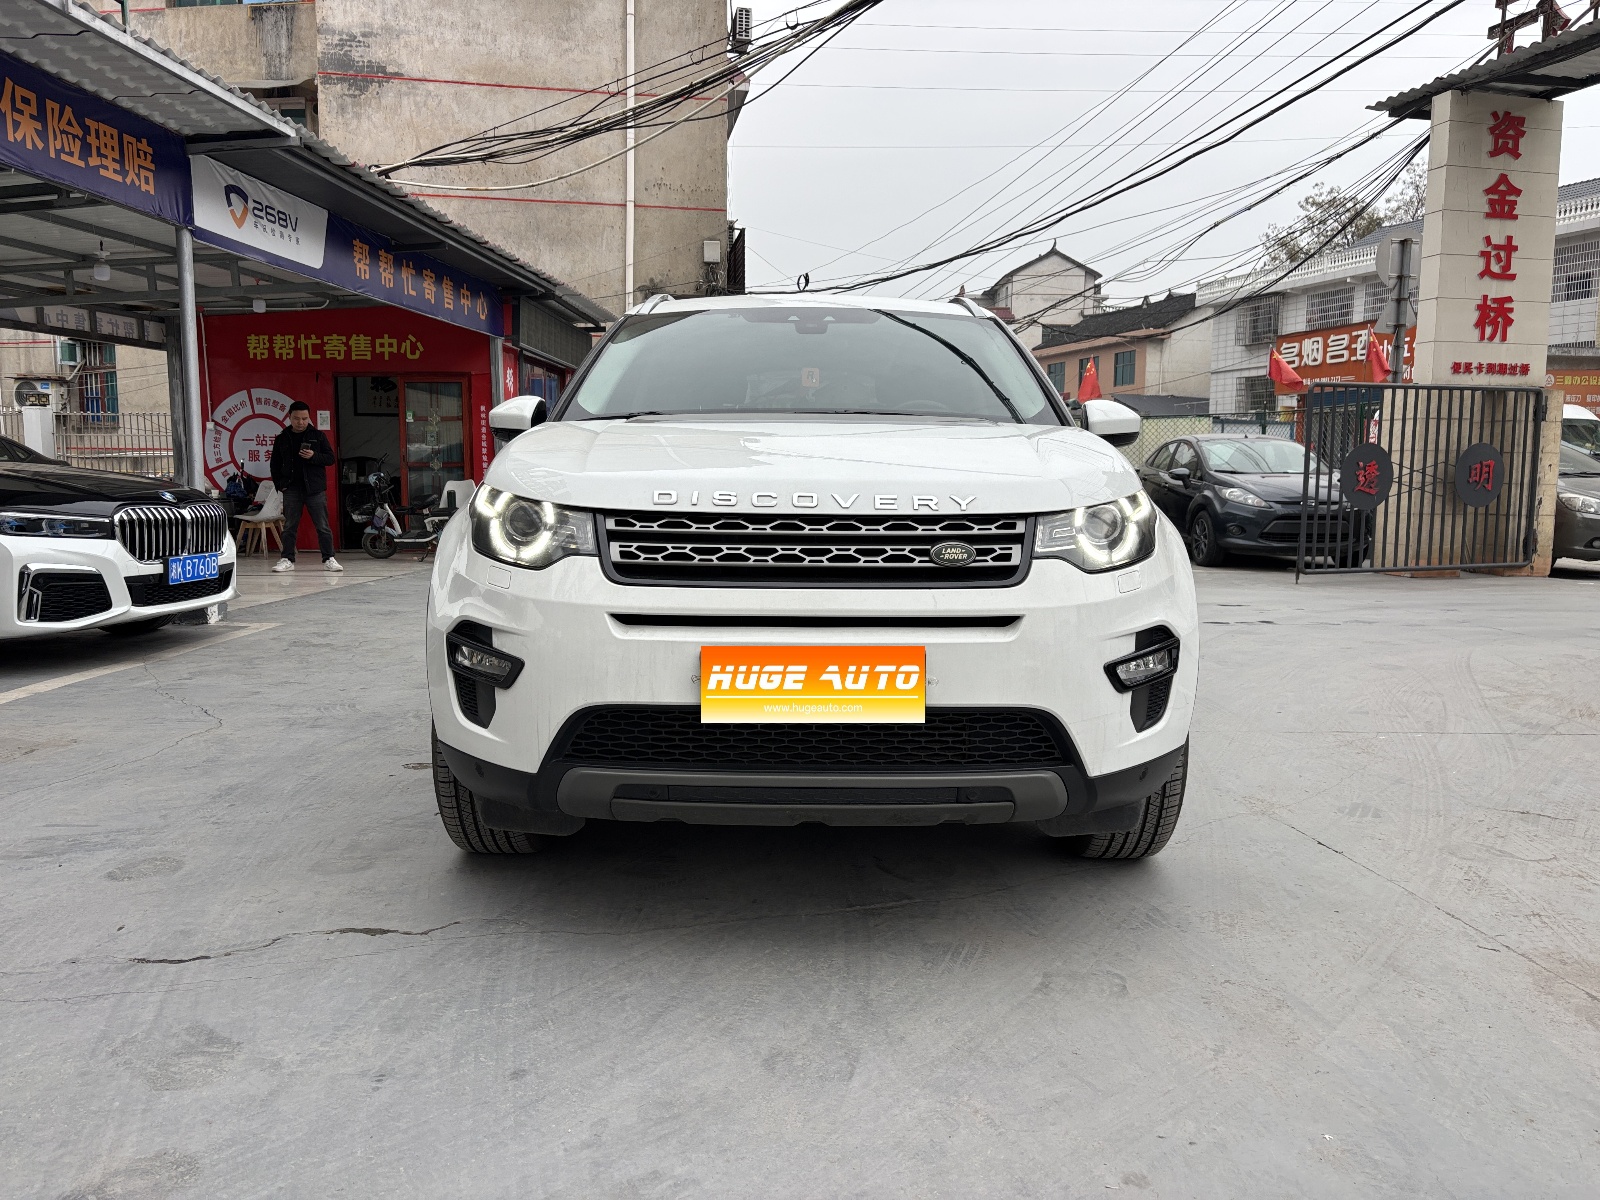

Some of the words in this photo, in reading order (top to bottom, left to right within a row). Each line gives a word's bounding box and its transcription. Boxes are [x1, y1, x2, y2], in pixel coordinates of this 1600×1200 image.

[0, 77, 156, 195] 保险理赔
[252, 199, 298, 232] 268V
[1474, 110, 1527, 343] 资金过桥
[352, 238, 489, 321] 帮帮忙寄售中心
[246, 334, 424, 361] 帮帮忙寄售中心
[221, 400, 248, 425] 全国比价
[1354, 460, 1380, 495] 透
[1467, 459, 1495, 491] 明
[652, 490, 977, 511] DISCOVERY
